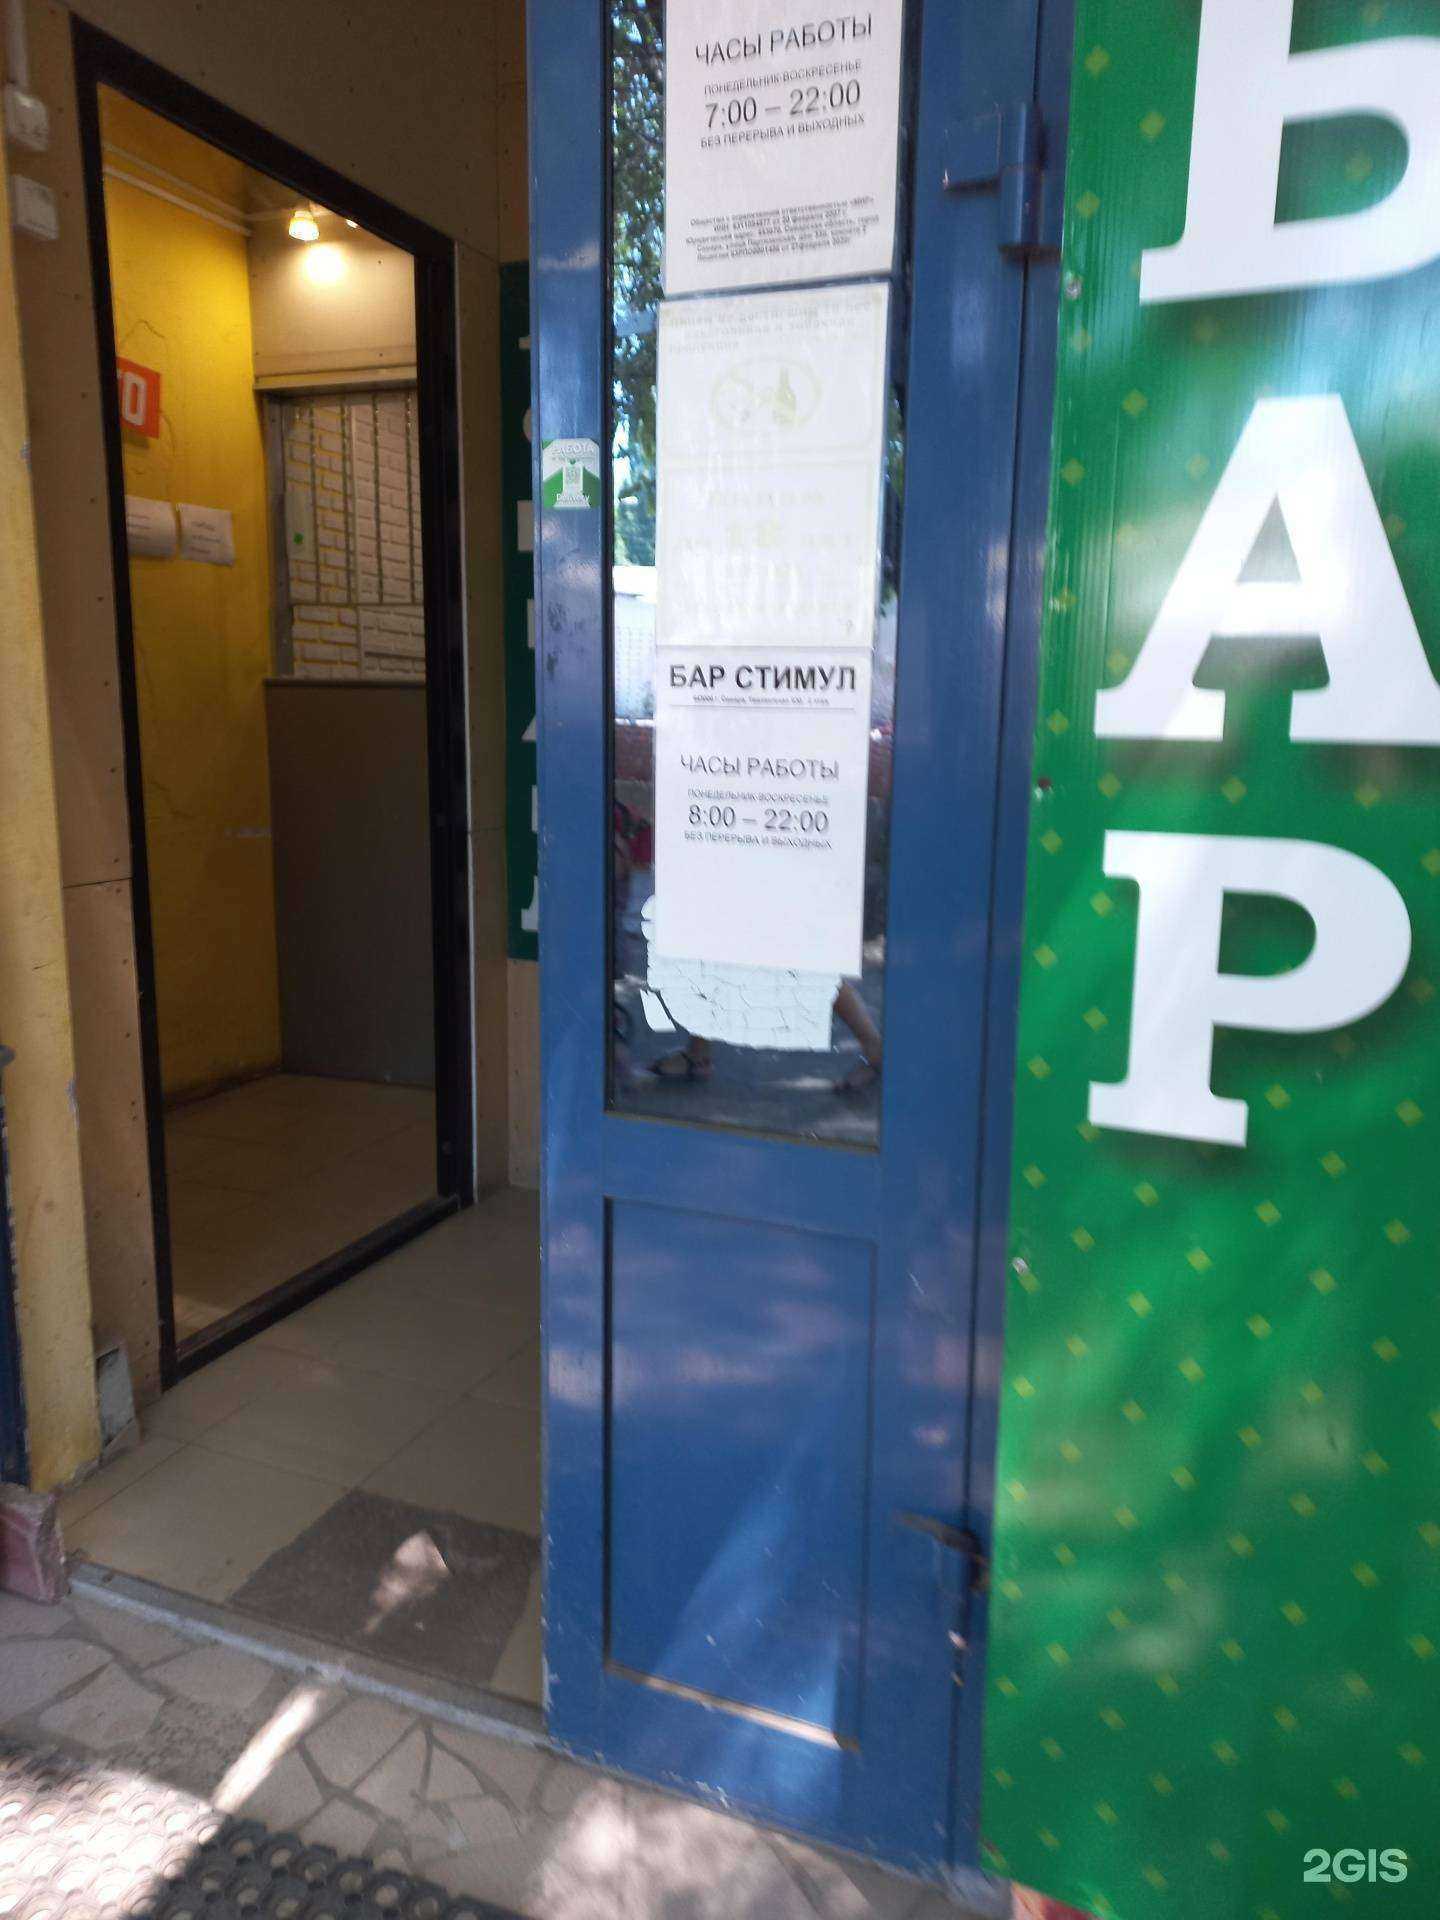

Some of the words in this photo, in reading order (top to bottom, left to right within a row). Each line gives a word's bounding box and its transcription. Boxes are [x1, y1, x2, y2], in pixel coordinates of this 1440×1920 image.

[695, 33, 762, 66] ЧАСЫ
[769, 13, 872, 54] РАБОТЫ
[705, 96, 757, 129] 7:00
[789, 79, 861, 116] 22:00
[700, 134, 721, 149] БЕЗ
[723, 126, 784, 145] ПЕРЕРЫВА
[787, 122, 795, 134] И
[797, 112, 865, 133] ВЫХОДНЫХ
[669, 664, 725, 689] БАР
[735, 665, 856, 691] СТИМУЛ
[680, 754, 741, 775] ЧАСЫ
[747, 757, 840, 779] РАБОТЫ
[688, 804, 736, 828] 8:00
[764, 808, 829, 832] 22:00
